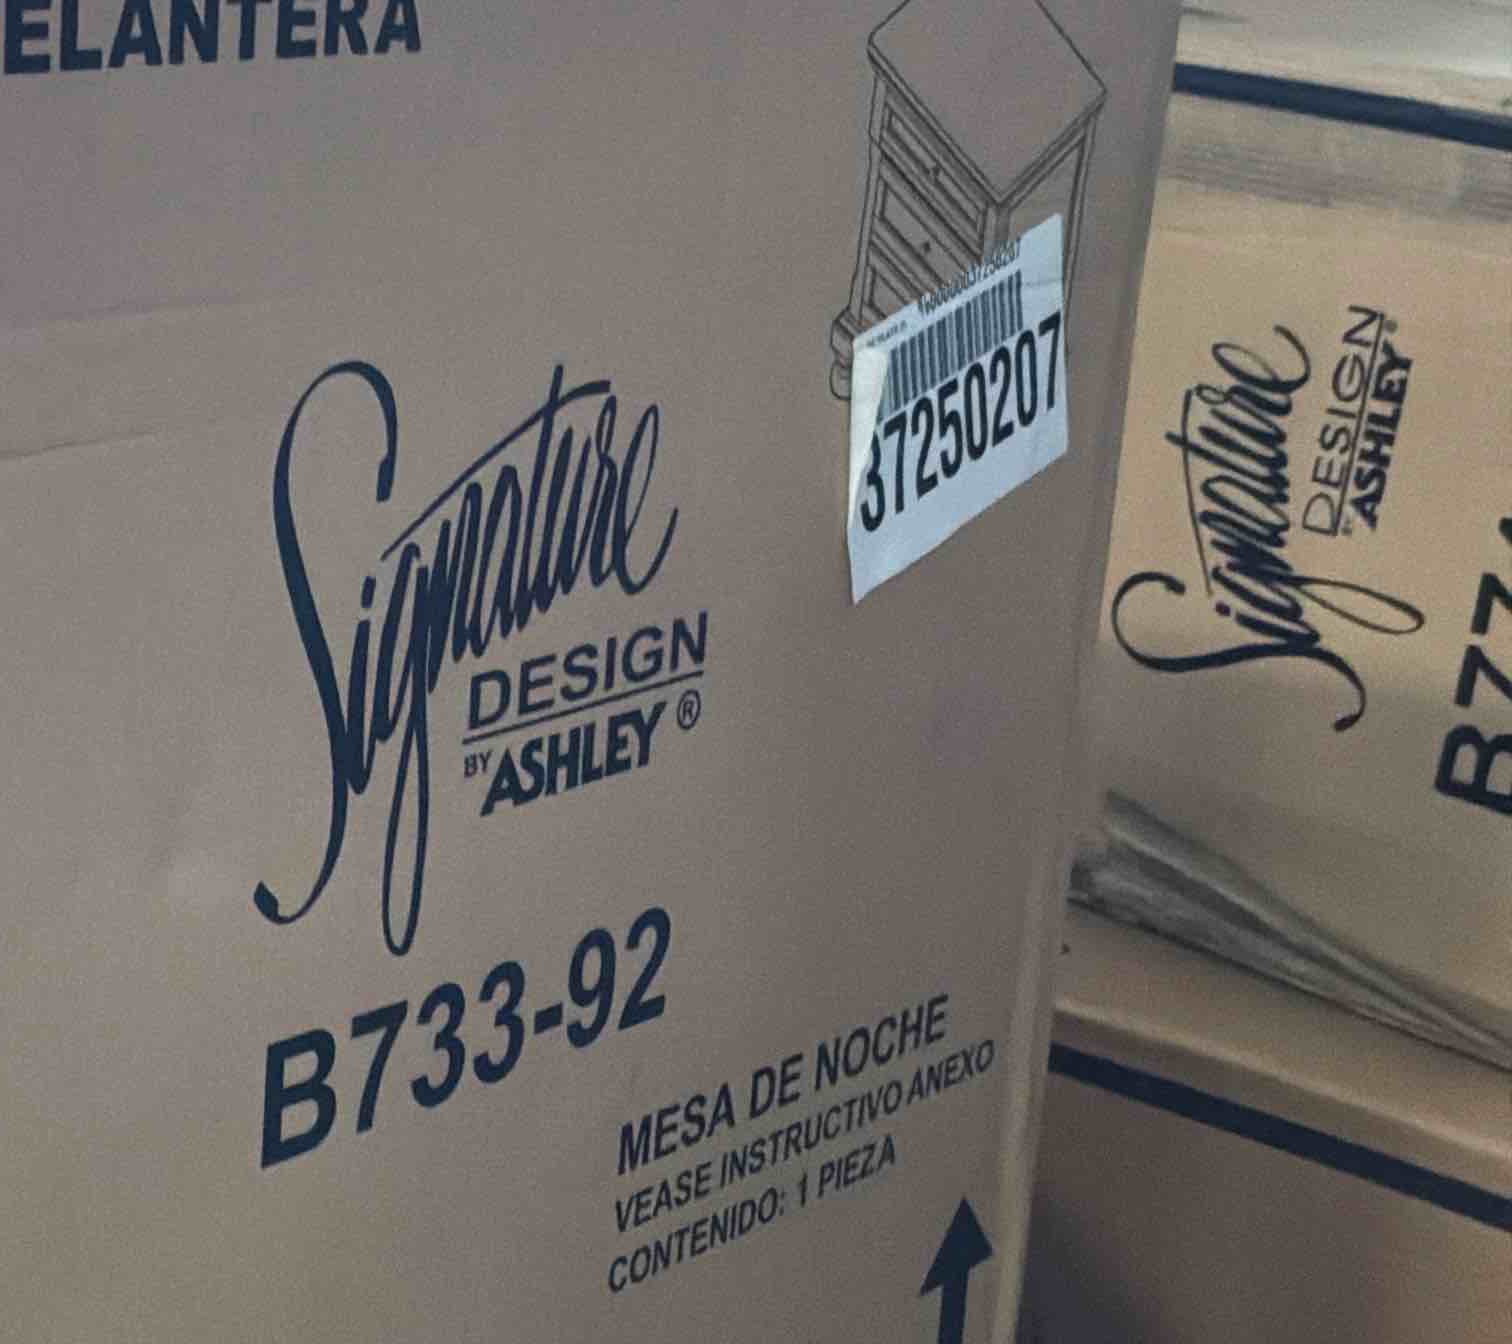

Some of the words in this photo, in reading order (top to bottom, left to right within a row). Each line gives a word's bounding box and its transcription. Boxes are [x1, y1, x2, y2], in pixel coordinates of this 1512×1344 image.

[860, 311, 1062, 533] 37250207
[1302, 304, 1382, 537] DESIGN
[1350, 339, 1413, 532] ASHLEY
[1112, 325, 1424, 732] Signature
[253, 360, 679, 956] Signature
[467, 611, 708, 731] DESIGN
[462, 751, 492, 779] BY
[480, 700, 668, 817] ASHLEY
[260, 906, 672, 1170] B733-92
[617, 1091, 735, 1176] MESA
[750, 1051, 802, 1117] DE
[814, 993, 950, 1093] NOCHE
[608, 1186, 786, 1294] CONTENIDO:
[797, 1176, 810, 1209] 1
[817, 1134, 898, 1194] PIEZA
[614, 1164, 713, 1234] VEASE
[719, 1080, 903, 1188] INSTRUCTIVO
[906, 1039, 996, 1118] ANEXO
